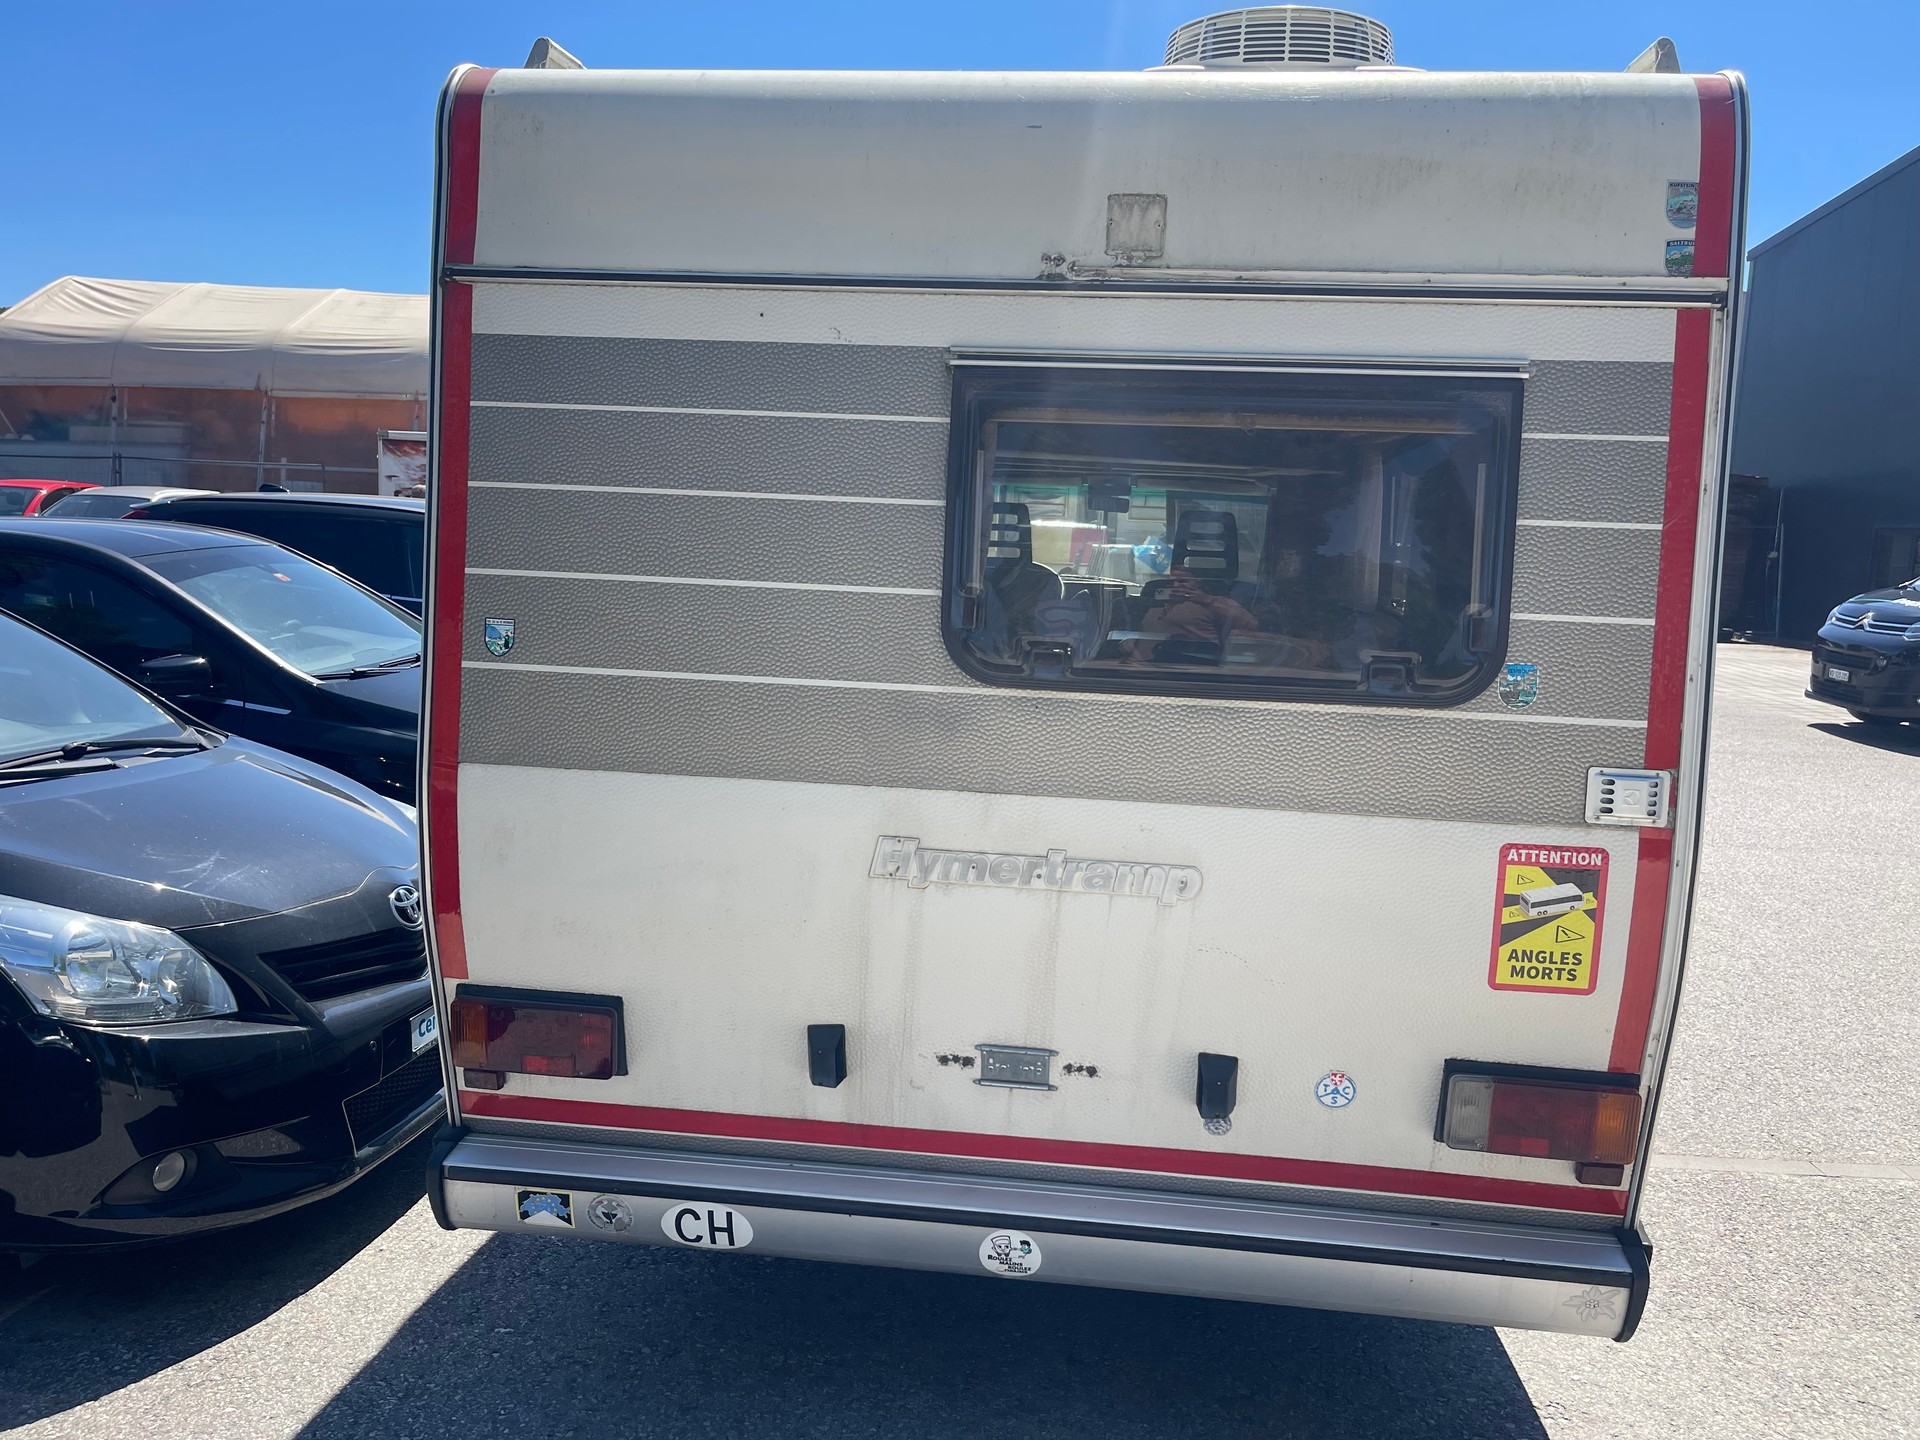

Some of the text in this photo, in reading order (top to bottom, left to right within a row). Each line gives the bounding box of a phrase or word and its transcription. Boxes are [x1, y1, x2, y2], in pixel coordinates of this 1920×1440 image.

[1507, 848, 1602, 866] ATTENTION
[870, 836, 1203, 906] Hymertramp
[1507, 948, 1583, 966] ANGLES
[1510, 964, 1577, 982] MORTS
[674, 1207, 736, 1247] CH
